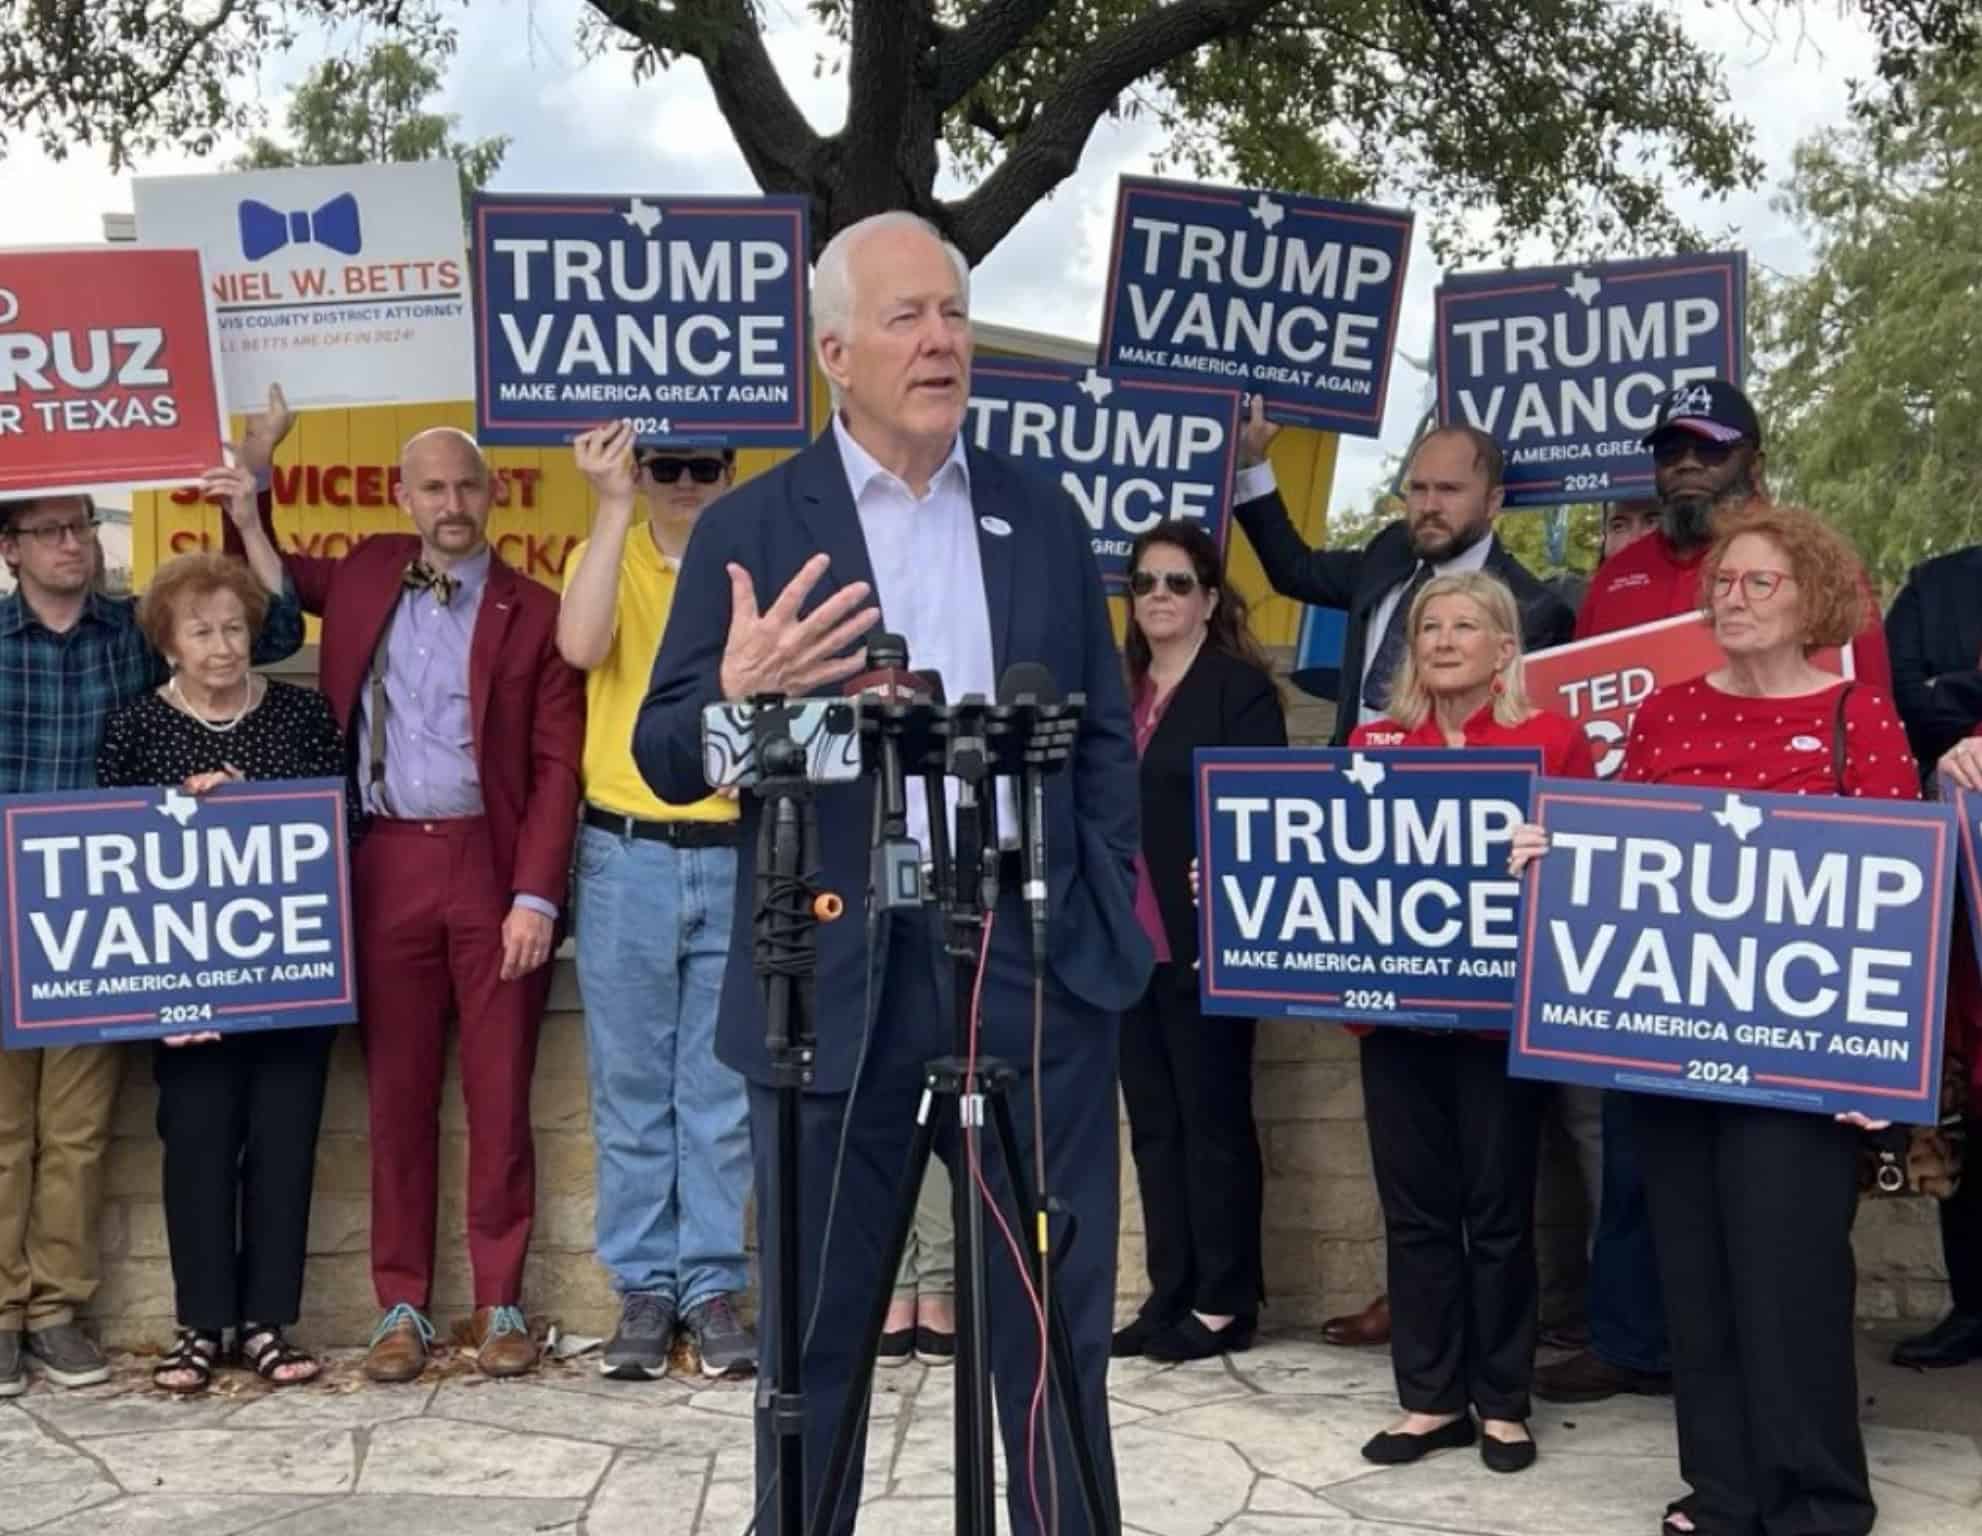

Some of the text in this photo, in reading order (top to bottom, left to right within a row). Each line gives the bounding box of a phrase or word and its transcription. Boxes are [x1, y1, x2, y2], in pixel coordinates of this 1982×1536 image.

[291, 268, 335, 297] W.
[344, 261, 461, 294] BETTS
[493, 239, 789, 302] TRUMP
[1132, 217, 1392, 301] TRUMP
[246, 312, 308, 328] COUNTY
[312, 308, 381, 324] DISTRICT
[385, 304, 463, 319] ATTORNEY
[1128, 284, 1379, 371] VANCE
[1452, 297, 1719, 378] TRUMP
[499, 313, 785, 376] VANCE
[1119, 346, 1371, 395] MAKE AMERICA GREAT AGAIN
[32, 395, 177, 431] TEXAS
[500, 383, 788, 403] MAKE AMERICA GREAT AGAIN
[967, 397, 1224, 471] TRUMP
[1512, 443, 1592, 463] AMERICA
[1596, 440, 1654, 458] GREA
[1565, 473, 1609, 491] 2024
[1558, 667, 1654, 718] TED
[1216, 797, 1524, 866] TRUMP
[22, 822, 330, 899] TRUMP
[1551, 831, 1924, 932] TRUMP
[29, 894, 332, 972] VANCE
[1221, 875, 1520, 949] VANCE
[32, 961, 335, 1000] MAKE AMERICA GREAT AGAIN
[1223, 950, 1278, 969] MAKE
[1282, 952, 1376, 974] AMERICA
[1380, 956, 1451, 976] GREAT
[1549, 919, 1912, 1028] VANCE
[160, 1003, 213, 1025] 2024
[1344, 989, 1396, 1010] 2024
[1541, 1002, 1909, 1062] MAKE AMERICA GREAT AGAIN
[1686, 1059, 1751, 1085] 2024
